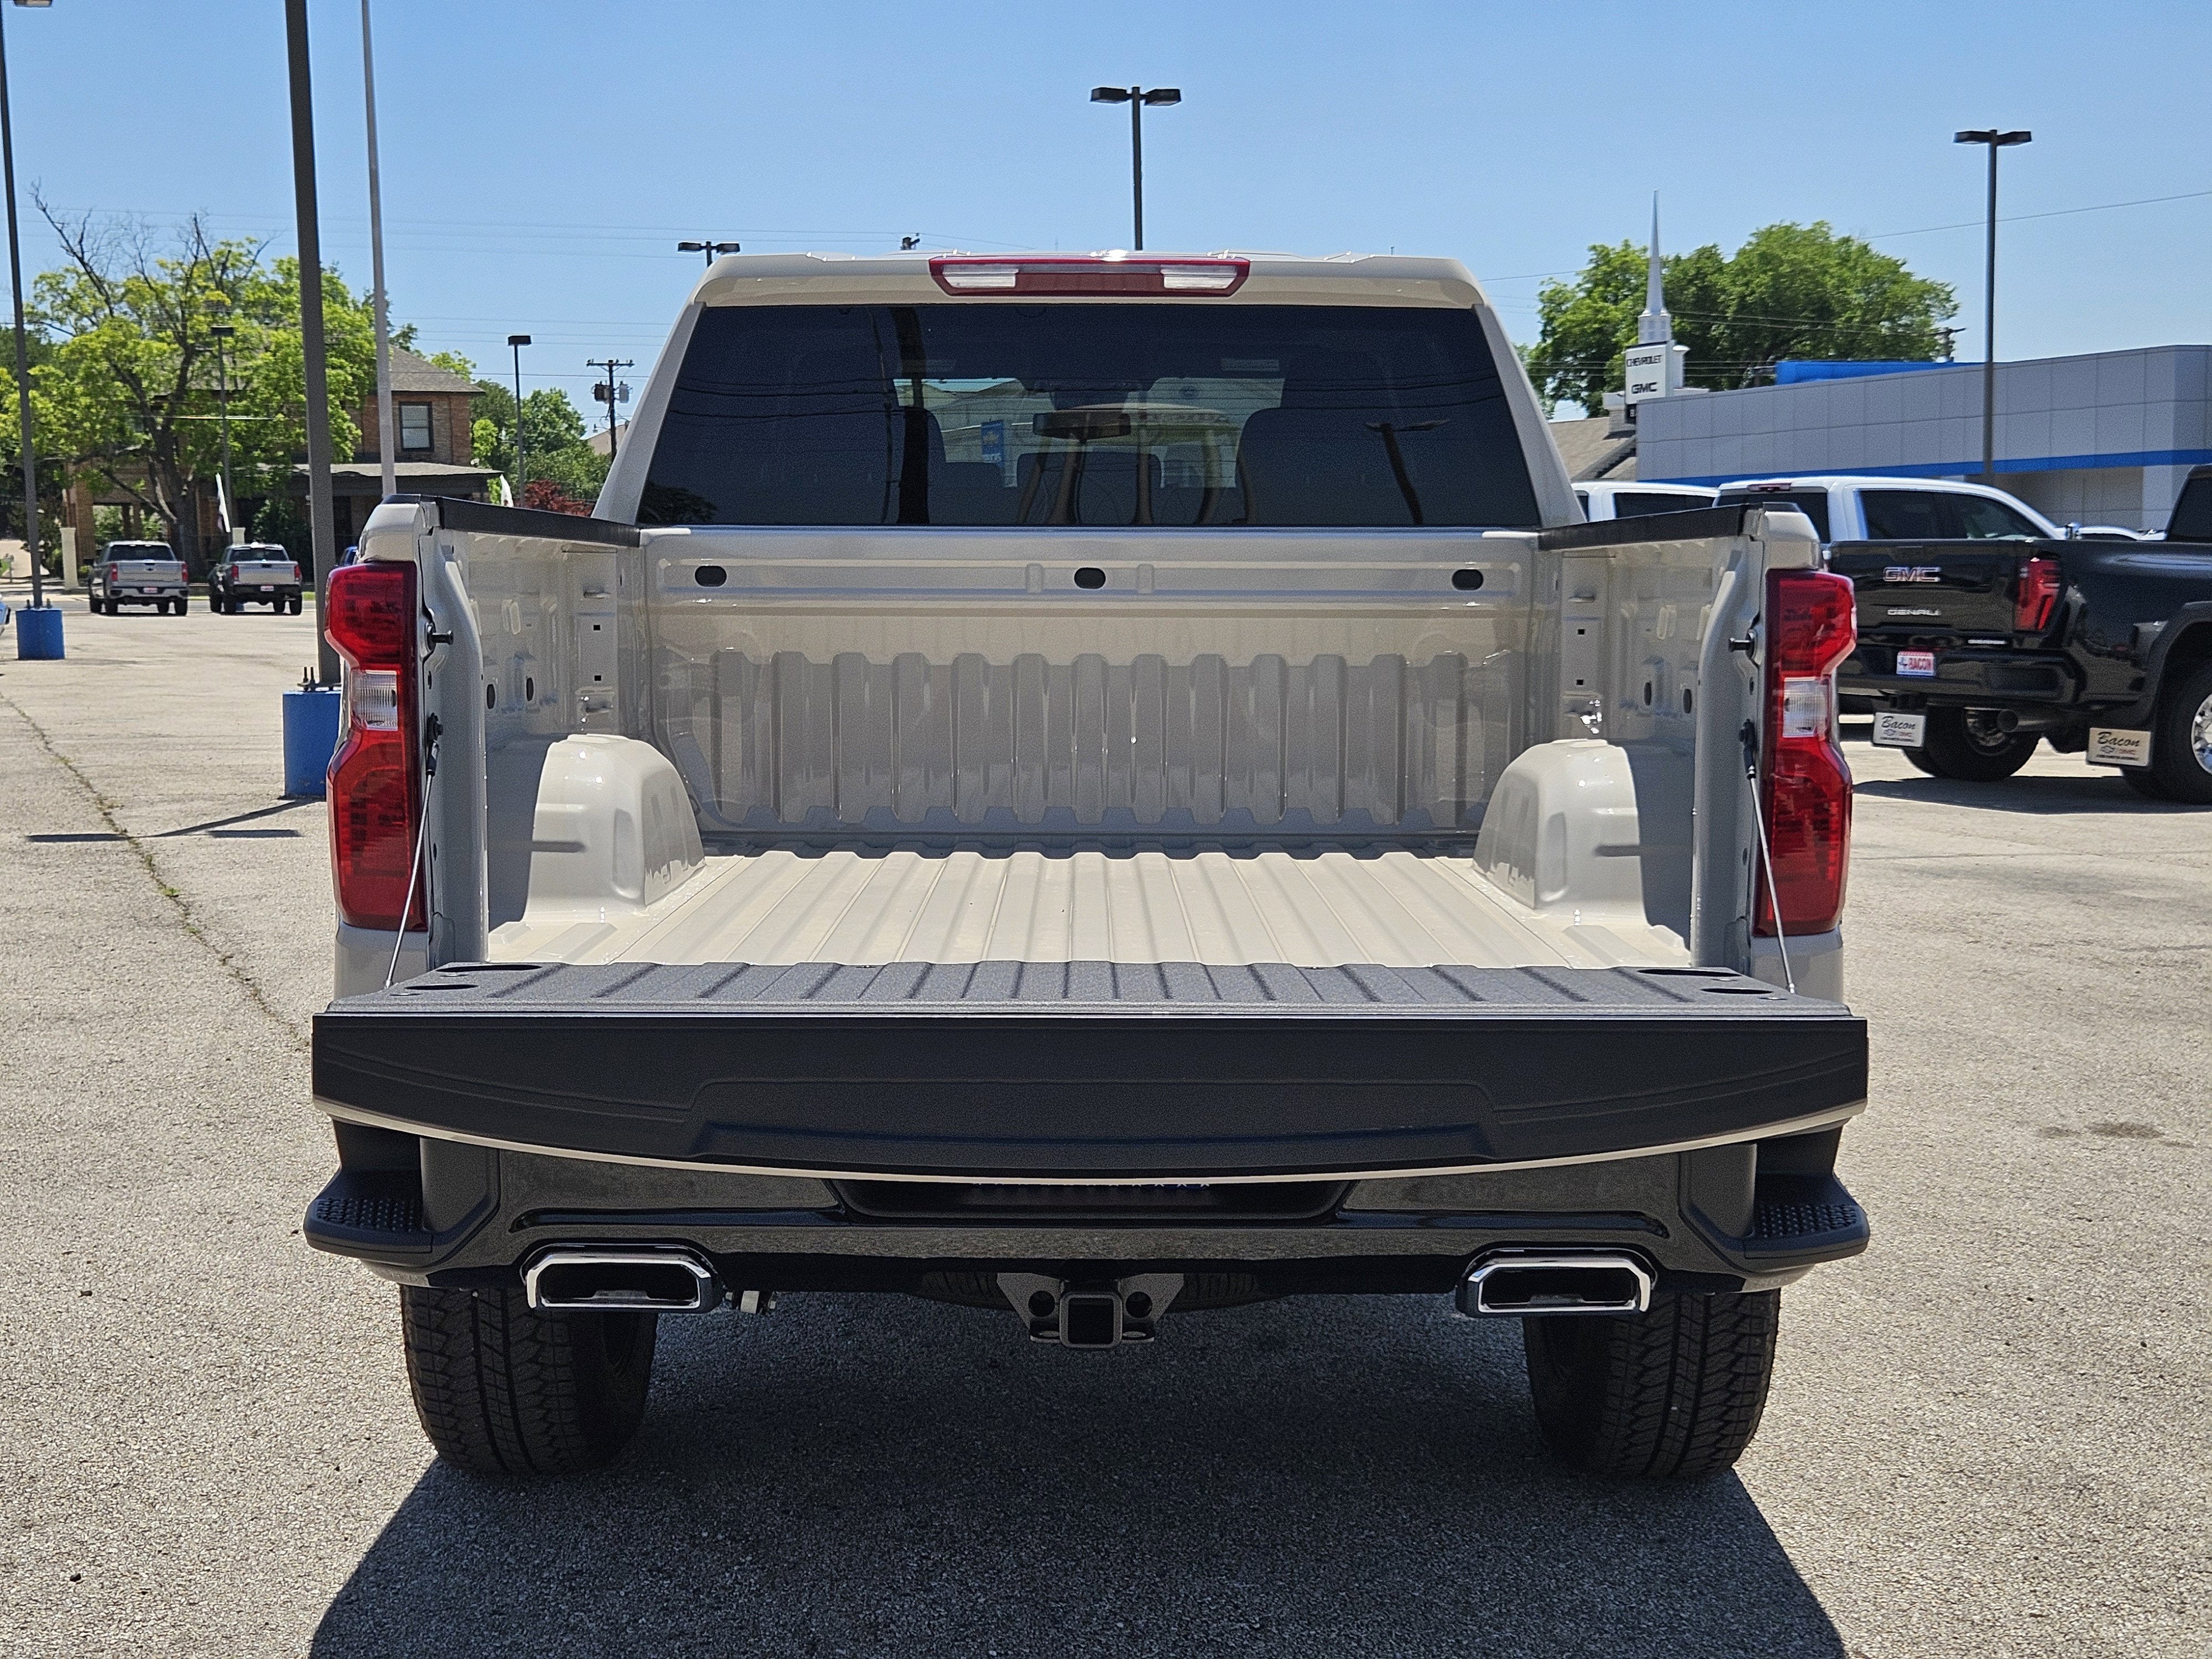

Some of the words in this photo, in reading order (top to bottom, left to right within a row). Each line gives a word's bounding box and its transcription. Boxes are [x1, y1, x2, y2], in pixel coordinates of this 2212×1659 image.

[1631, 382, 1657, 394] GMC
[1883, 567, 1942, 582] GMC
[1909, 658, 1932, 670] BACON
[1881, 716, 1916, 729] Bacon
[2098, 732, 2140, 746] Bacon
